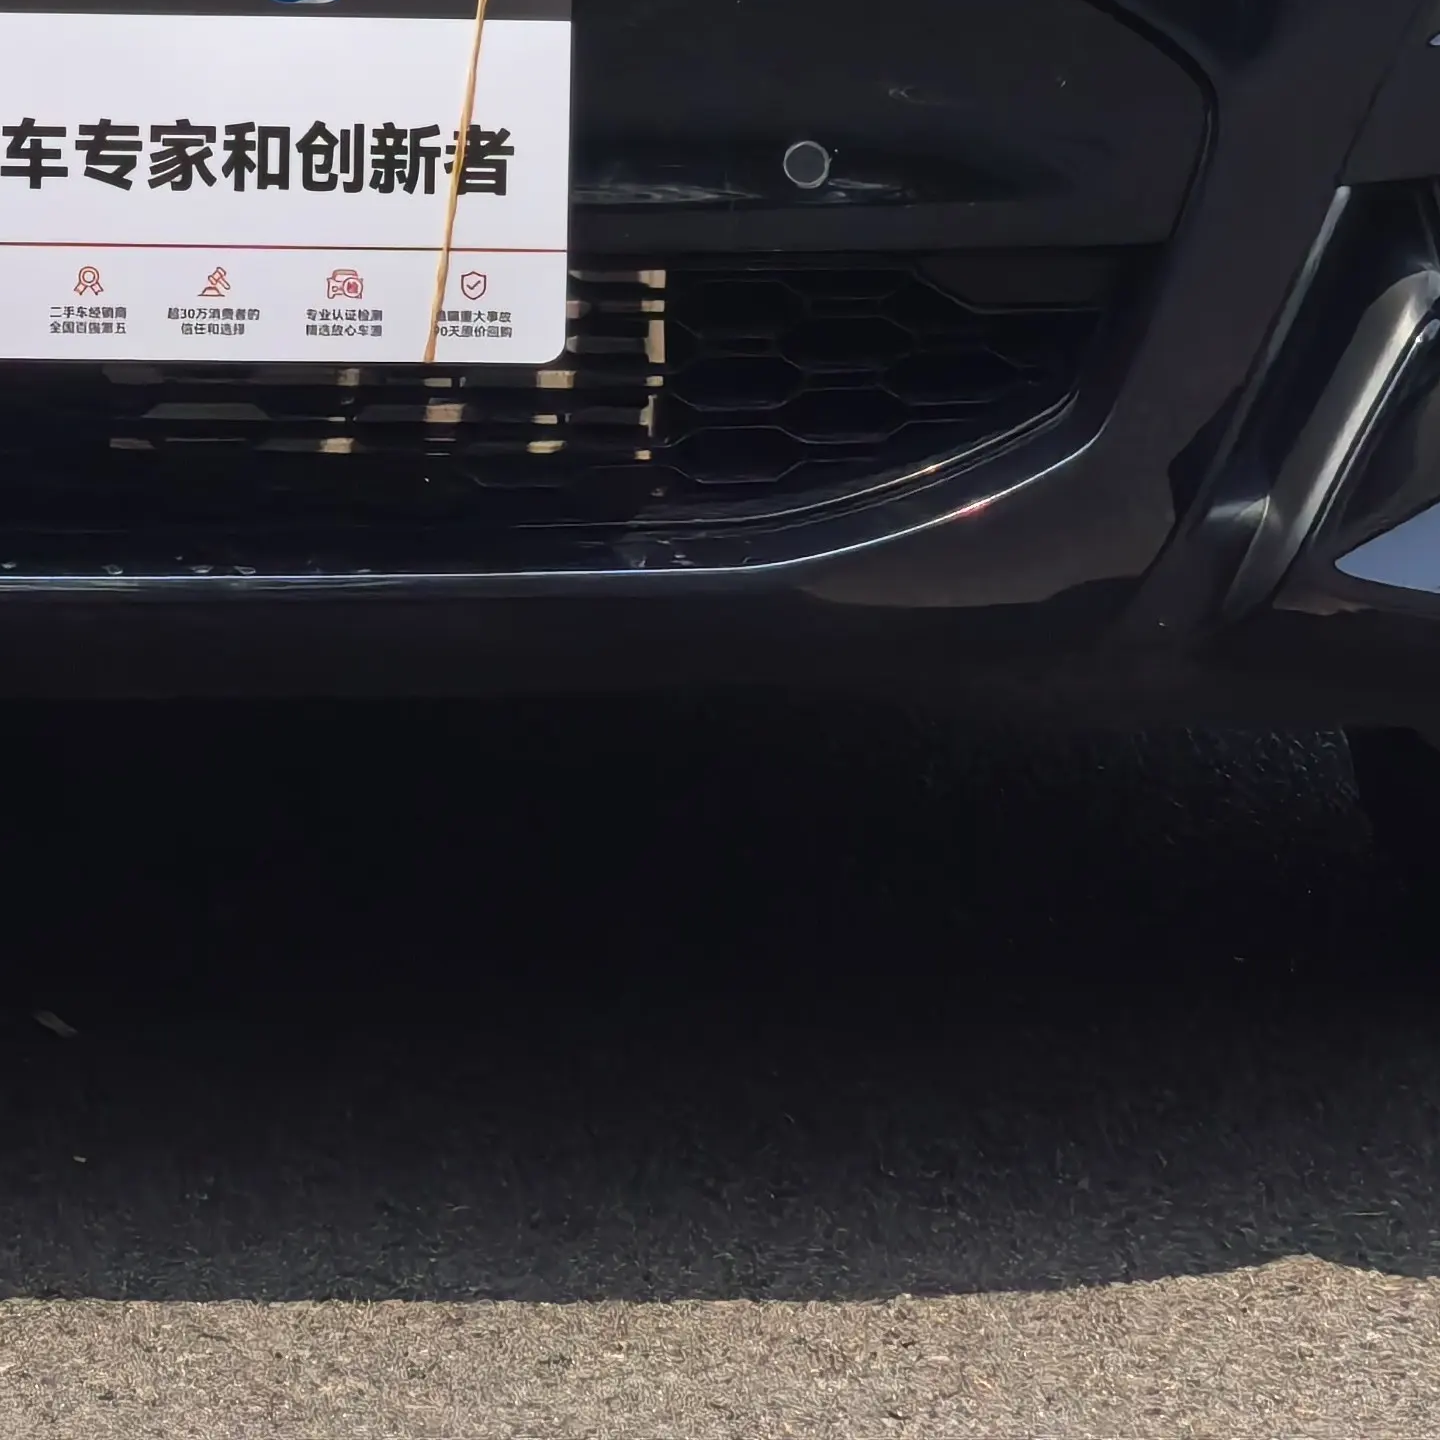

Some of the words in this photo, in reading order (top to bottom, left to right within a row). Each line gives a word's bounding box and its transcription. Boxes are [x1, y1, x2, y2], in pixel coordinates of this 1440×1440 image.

[49, 306, 127, 319] 二手车经销商
[306, 308, 383, 322] 专业认证检测
